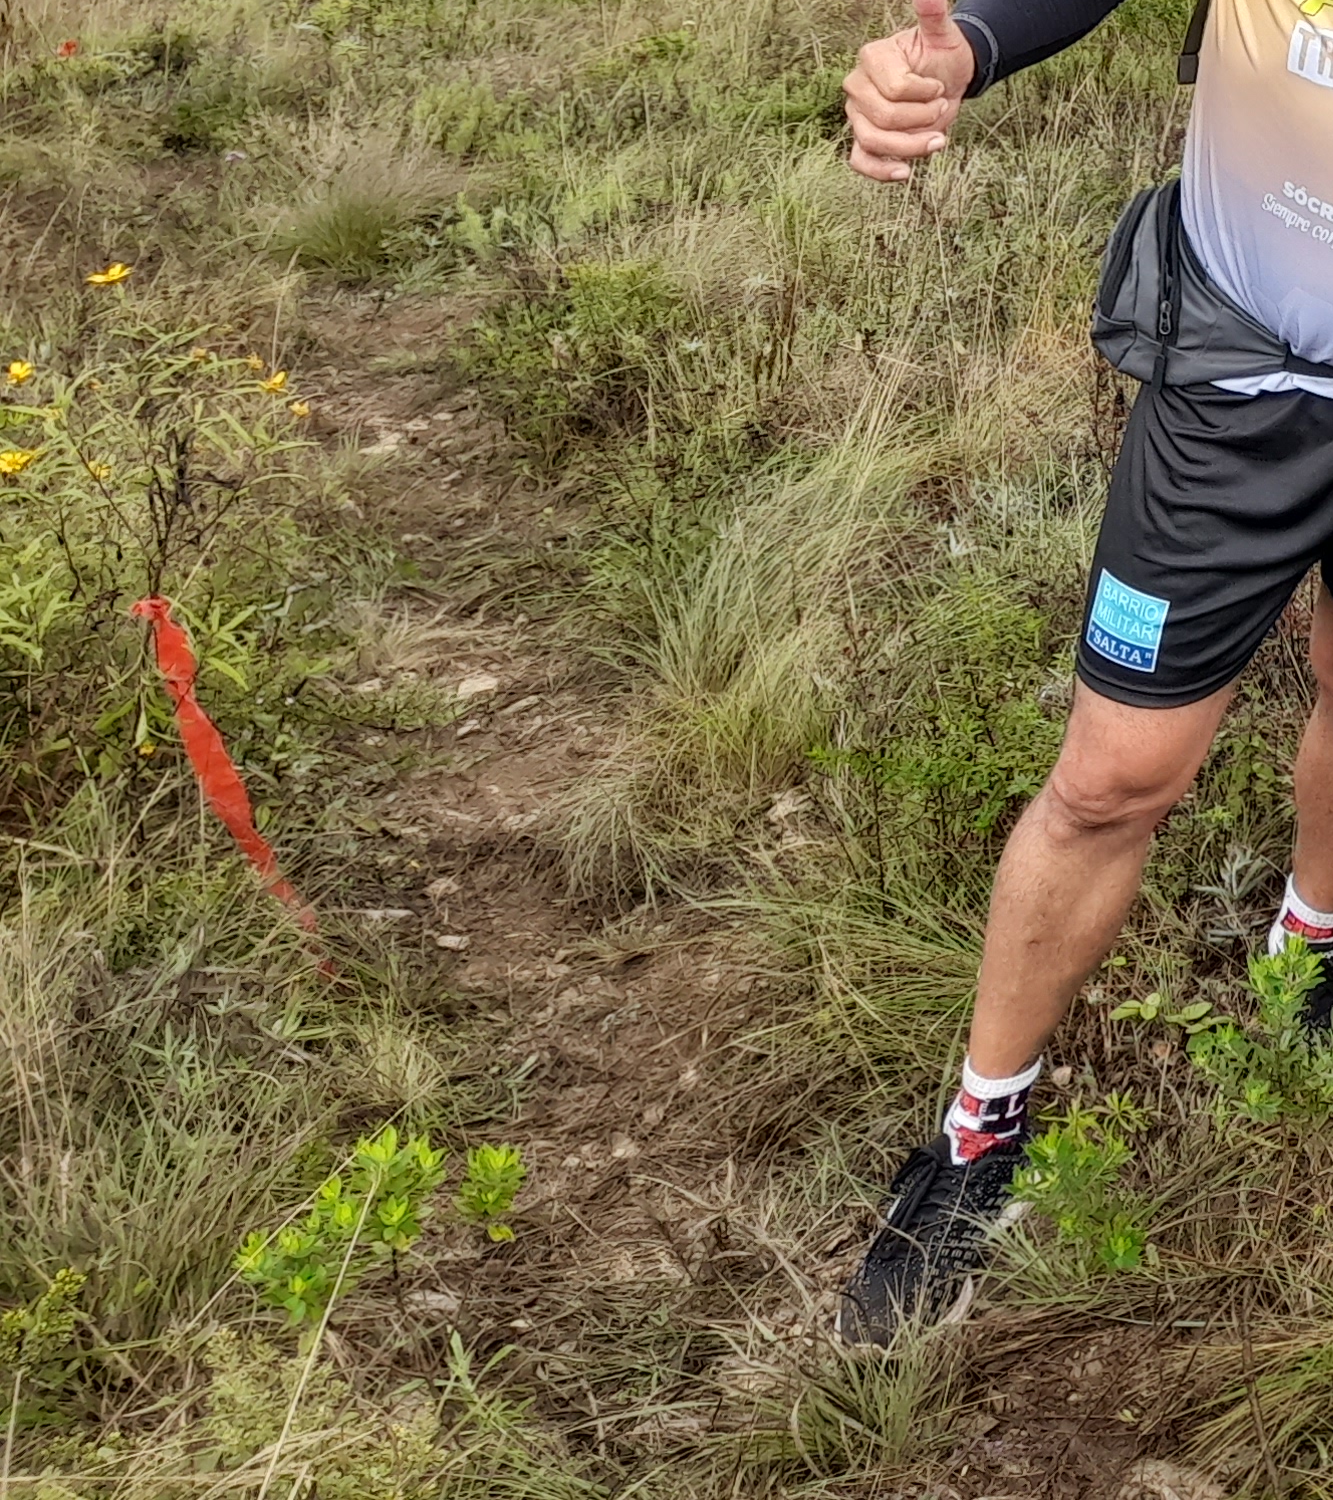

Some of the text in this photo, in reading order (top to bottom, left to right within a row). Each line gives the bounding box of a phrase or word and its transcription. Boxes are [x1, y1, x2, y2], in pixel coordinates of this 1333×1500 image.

[1261, 193, 1311, 229] Siempre
[1097, 601, 1155, 640] MILITAR
[1102, 581, 1159, 621] BARRIO
